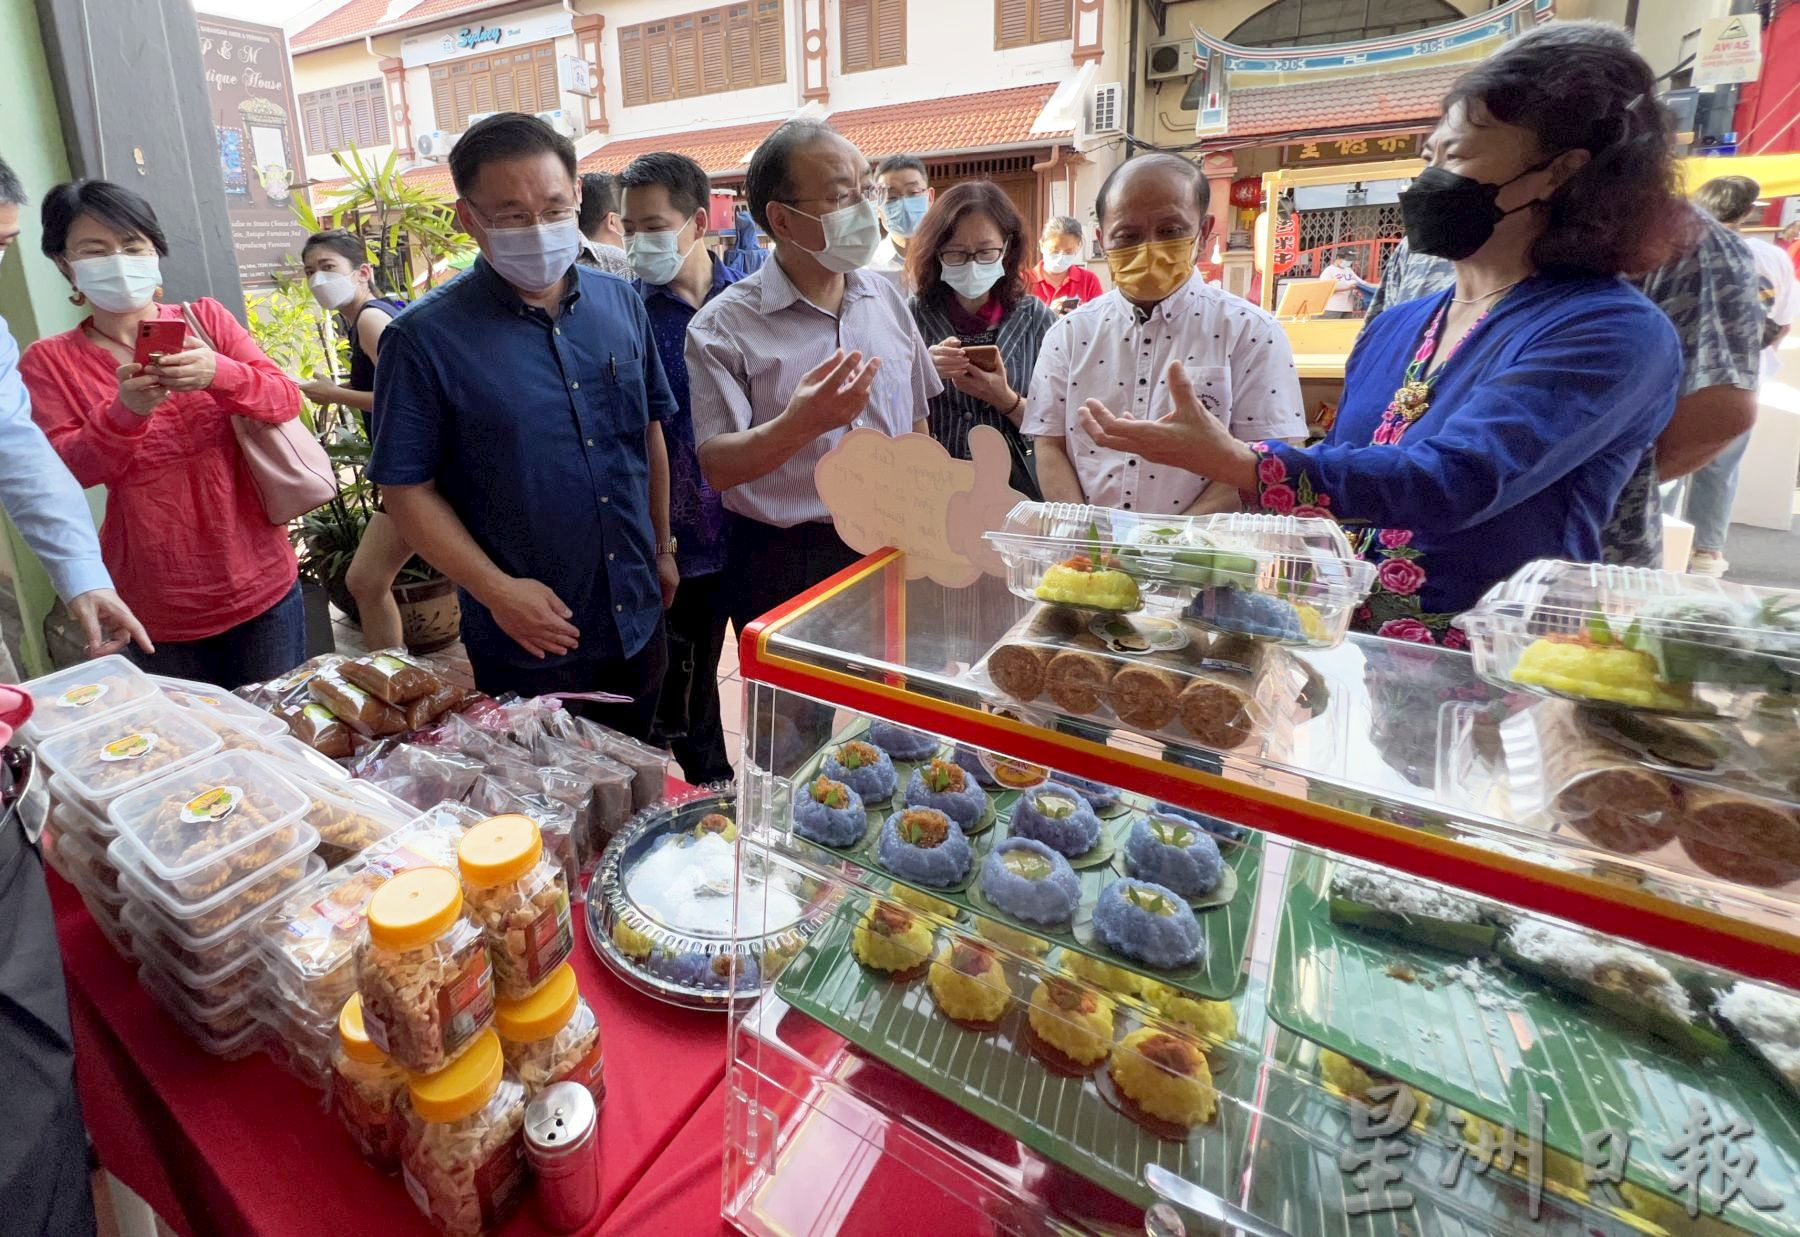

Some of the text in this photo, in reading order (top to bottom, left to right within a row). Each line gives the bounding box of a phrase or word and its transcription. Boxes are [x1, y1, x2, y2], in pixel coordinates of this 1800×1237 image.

[457, 26, 503, 49] Sydney
[1712, 40, 1750, 52] AWAS
[217, 40, 233, 60] &
[237, 45, 263, 65] M
[205, 67, 282, 97] tique House
